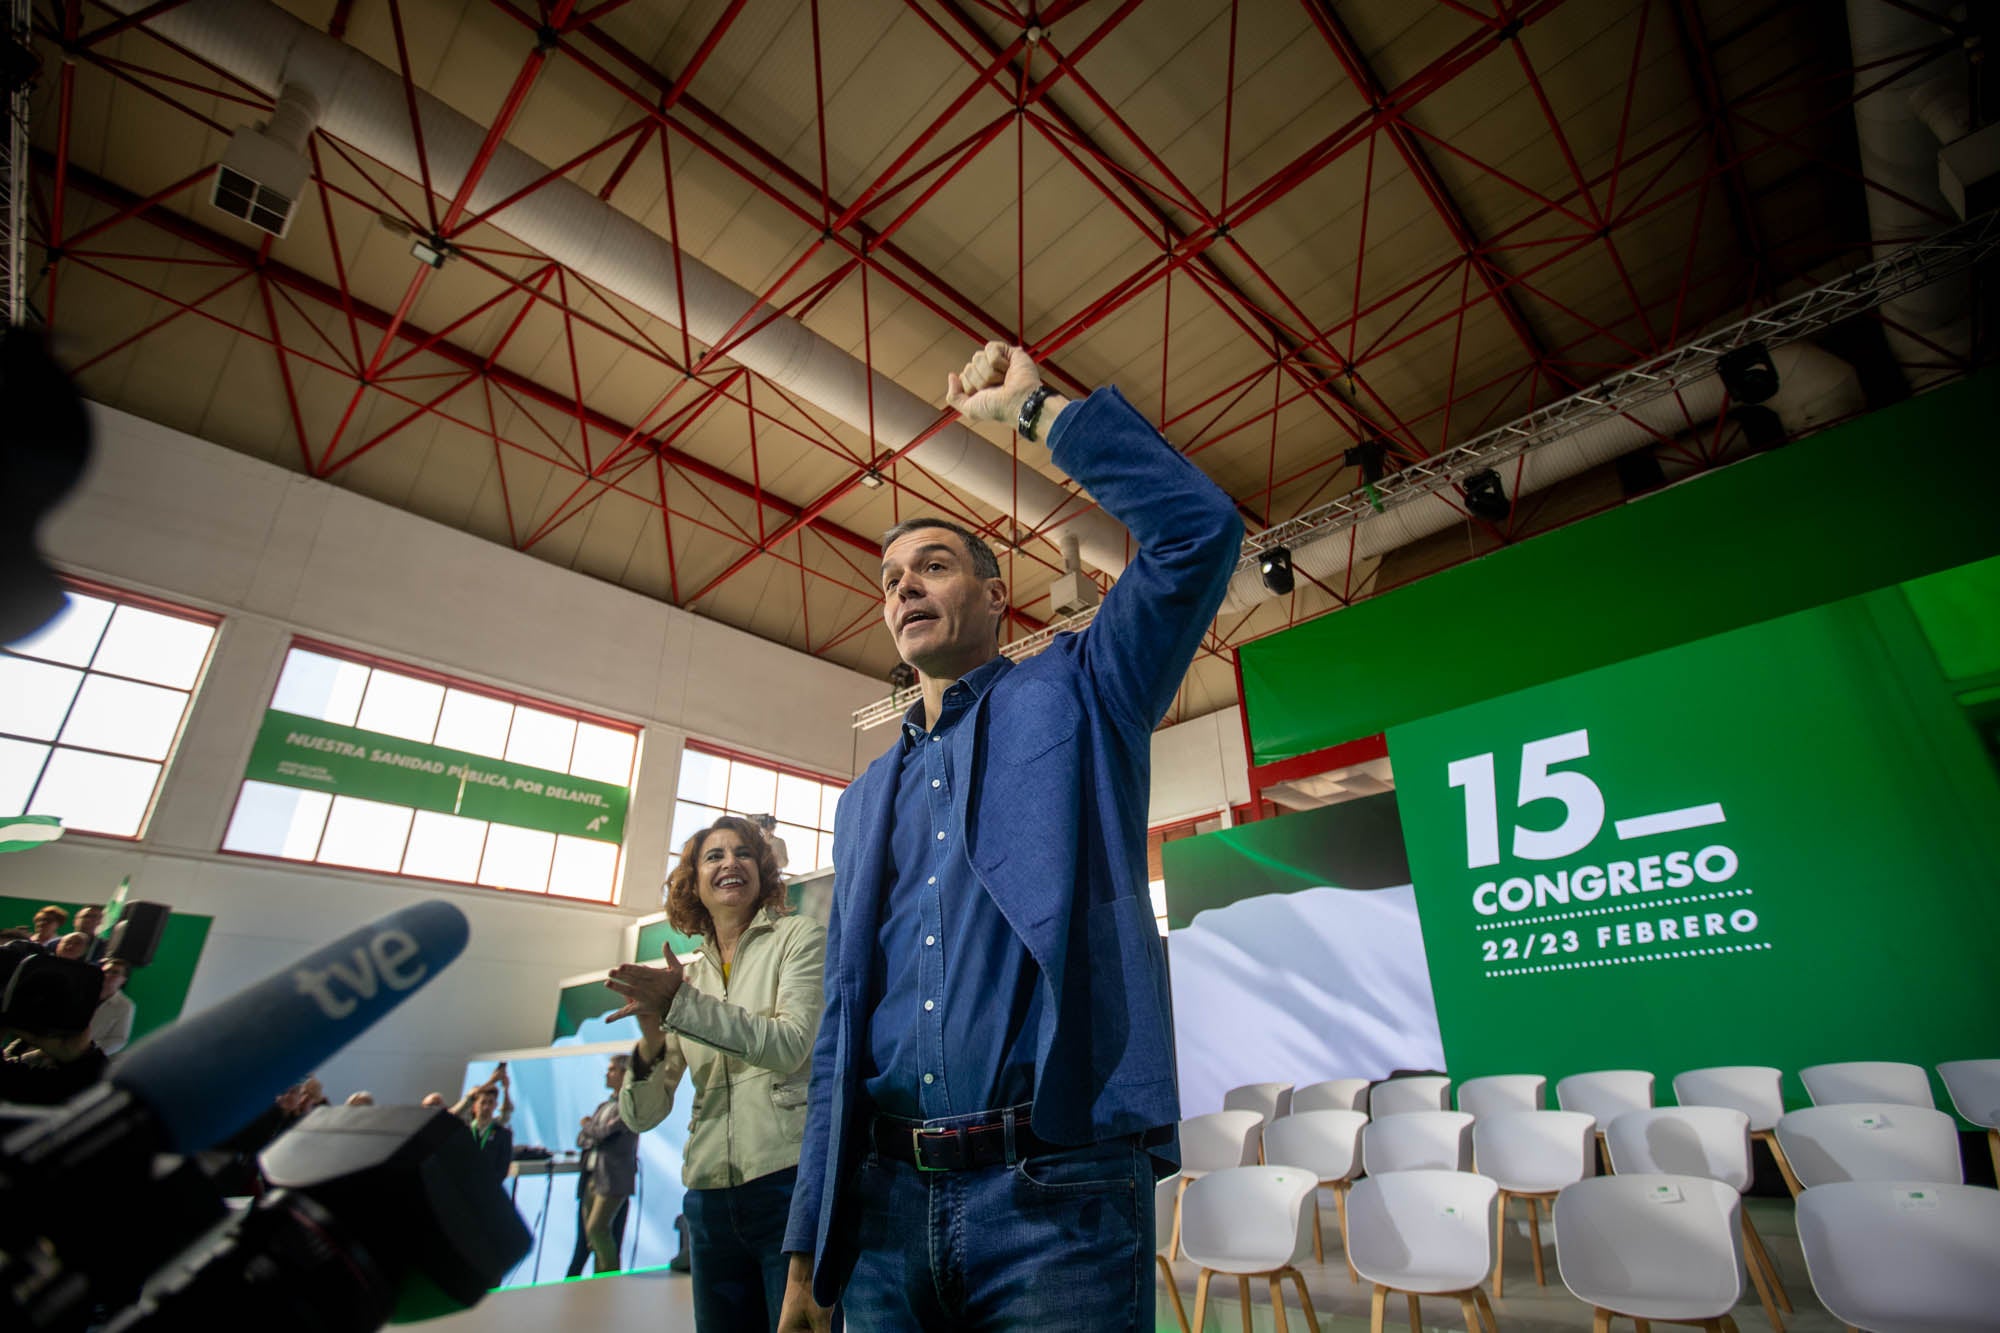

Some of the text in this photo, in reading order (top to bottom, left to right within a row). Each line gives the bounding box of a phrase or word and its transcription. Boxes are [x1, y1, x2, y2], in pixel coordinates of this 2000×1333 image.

[286, 732, 366, 758] NUESTRA
[369, 749, 445, 775] SANIDAD
[514, 778, 544, 796] POR
[1472, 844, 1739, 915] CONGRESO
[1482, 908, 1759, 962] 22/23 FEBRERO
[295, 929, 427, 1019] tve
